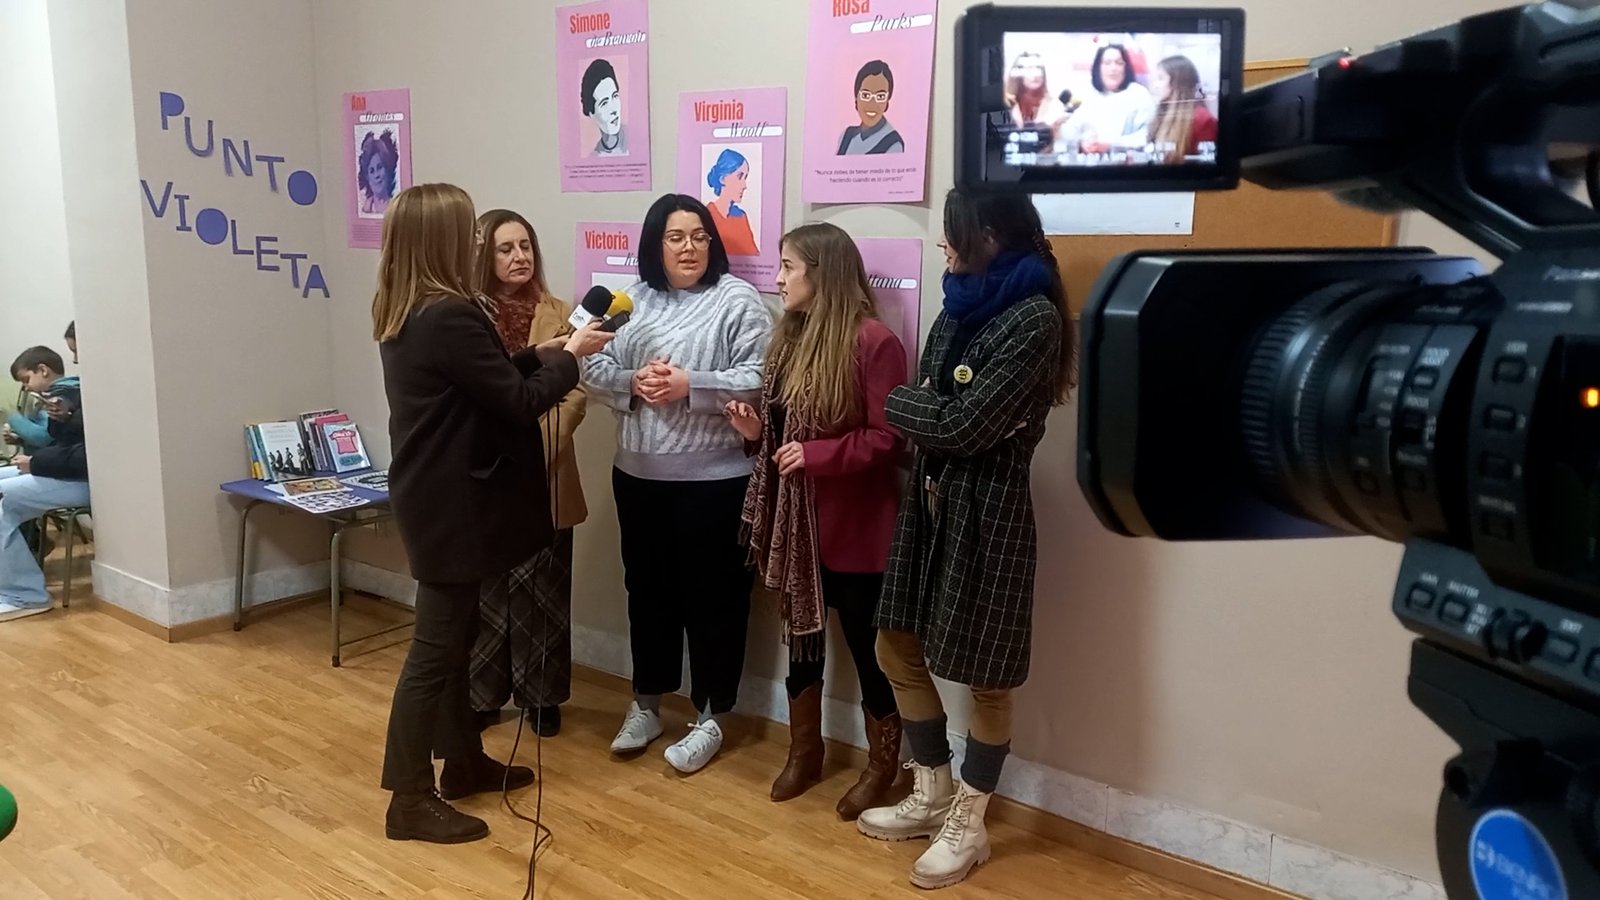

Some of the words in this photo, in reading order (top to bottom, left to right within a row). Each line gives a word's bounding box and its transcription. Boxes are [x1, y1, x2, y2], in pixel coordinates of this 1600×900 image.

[570, 13, 610, 34] Simone
[870, 12, 914, 32] Parks
[694, 99, 744, 123] Virginia
[731, 121, 768, 137] Woolf
[160, 91, 318, 206] PUNTO
[140, 179, 330, 298] VIOLETA
[585, 230, 629, 250] Victoria
